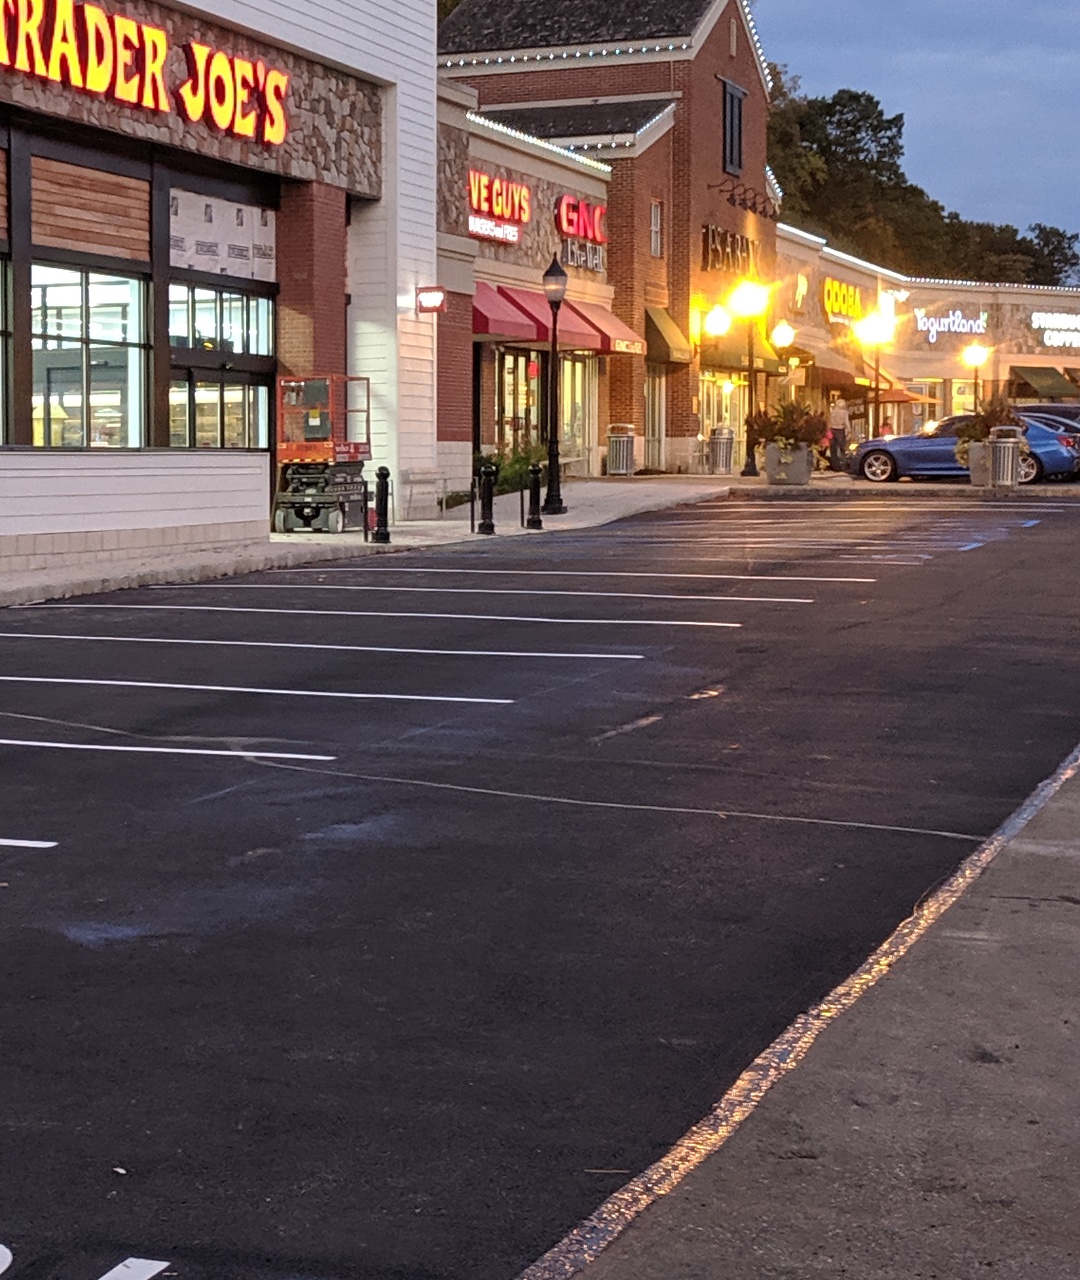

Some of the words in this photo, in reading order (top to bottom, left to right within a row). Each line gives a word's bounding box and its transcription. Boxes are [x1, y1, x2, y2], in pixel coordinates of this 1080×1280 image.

[178, 41, 290, 146] JOE'S
[469, 170, 490, 212] VE
[491, 177, 531, 224] GUYS
[558, 194, 608, 243] GNC
[824, 276, 863, 323] QDOBA
[913, 307, 986, 343] Yogurtland
